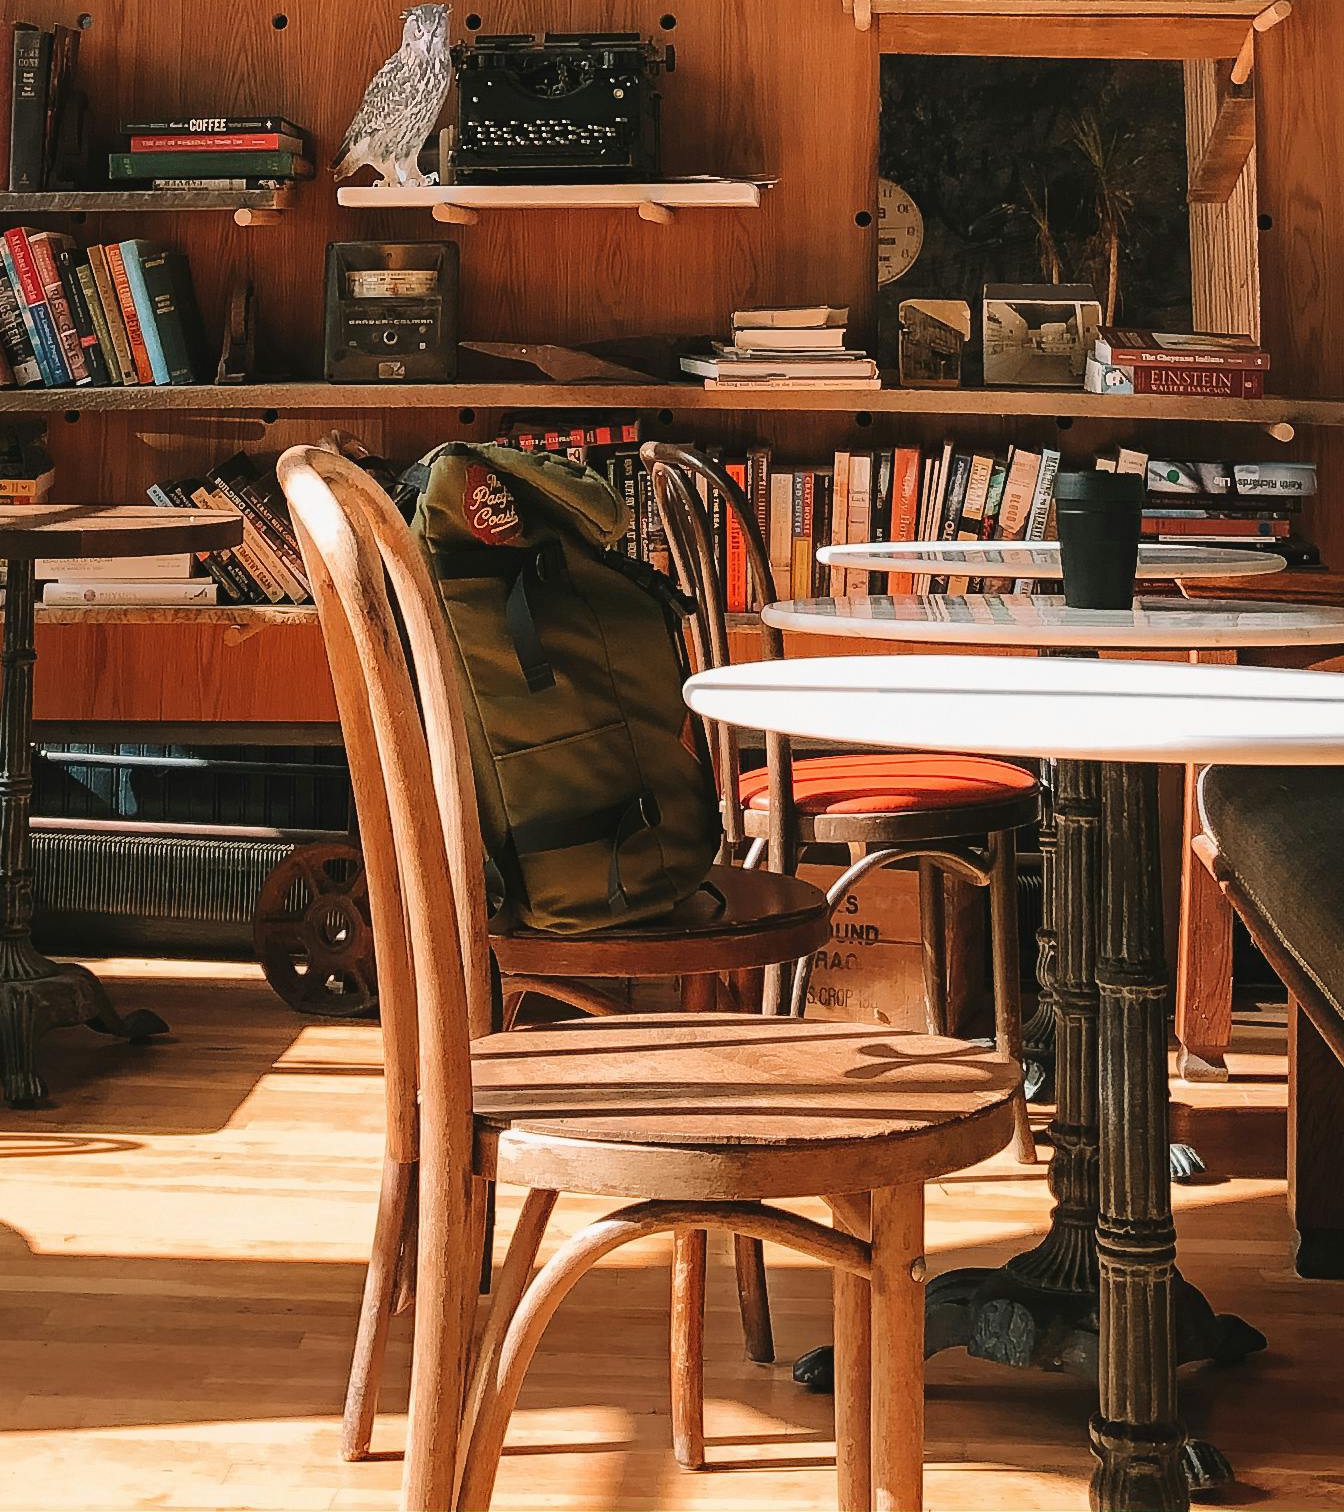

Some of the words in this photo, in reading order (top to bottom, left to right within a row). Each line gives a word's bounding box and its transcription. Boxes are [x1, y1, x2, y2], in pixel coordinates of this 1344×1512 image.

[189, 118, 227, 132] COFFEE
[10, 234, 30, 271] Michael
[22, 272, 38, 301] Lewis
[110, 249, 126, 283] CHARLIE
[49, 287, 66, 319] RISK
[61, 323, 80, 363] GAME
[1142, 354, 1156, 362] The
[1157, 354, 1194, 364] Cheyenne
[1195, 355, 1225, 363] Indians
[1151, 370, 1232, 387] EINSTEIN
[1151, 384, 1186, 392] WALTER
[1188, 386, 1232, 395] ISAACSON
[794, 476, 803, 496] AND
[803, 476, 812, 504] CRAZY
[1038, 456, 1059, 497] MARCHING
[1238, 478, 1277, 489] Richards
[1279, 479, 1303, 490] Keith
[214, 477, 246, 510] BUILDING
[900, 472, 913, 511] Crazy
[474, 506, 519, 529] Coast
[794, 499, 802, 533] CUSTER
[803, 506, 811, 535] HORSE
[1005, 493, 1023, 523] BLOOD
[237, 546, 260, 573] TIMOTHY
[257, 571, 274, 590] EGAN
